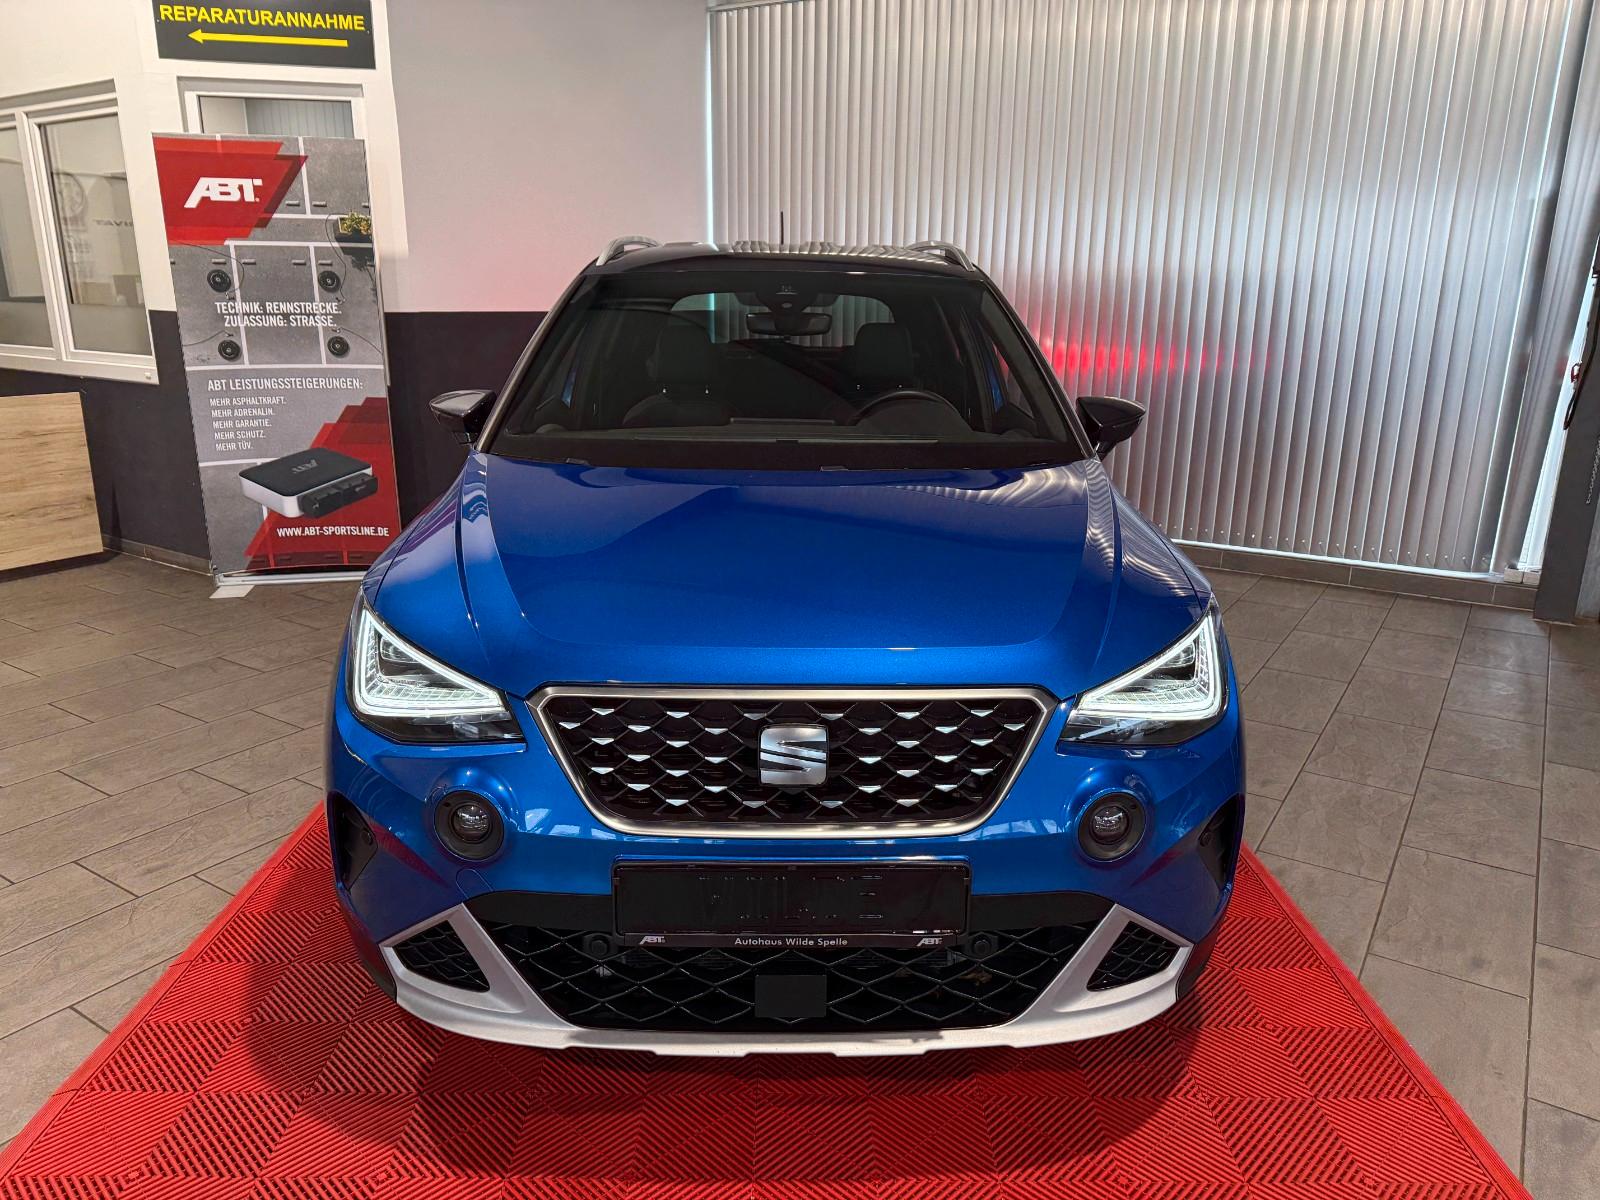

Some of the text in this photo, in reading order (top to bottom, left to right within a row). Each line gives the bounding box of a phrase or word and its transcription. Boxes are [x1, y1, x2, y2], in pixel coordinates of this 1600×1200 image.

[159, 4, 366, 31] REPARATURANNAHME
[214, 301, 342, 314] TECHNIK: RENNSTRECKE.
[223, 315, 337, 327] ZULASSUNG: STRASSE.
[207, 377, 364, 391] ABT LEISTUNGSSTEIGERUNGEN:
[210, 396, 287, 407] MEHR ASPHALTKRAFT.
[211, 408, 275, 418] MEHR ADRENALIN.
[213, 419, 272, 429] MEHR GARANTIE.
[214, 430, 266, 440] MEHR SCHUTZ.
[215, 441, 254, 451] MEHR TÜV.
[277, 526, 389, 537] WWW.ABT-SPORTSLINE.DE
[734, 937, 848, 947] Autohaus Wilde Spelle
